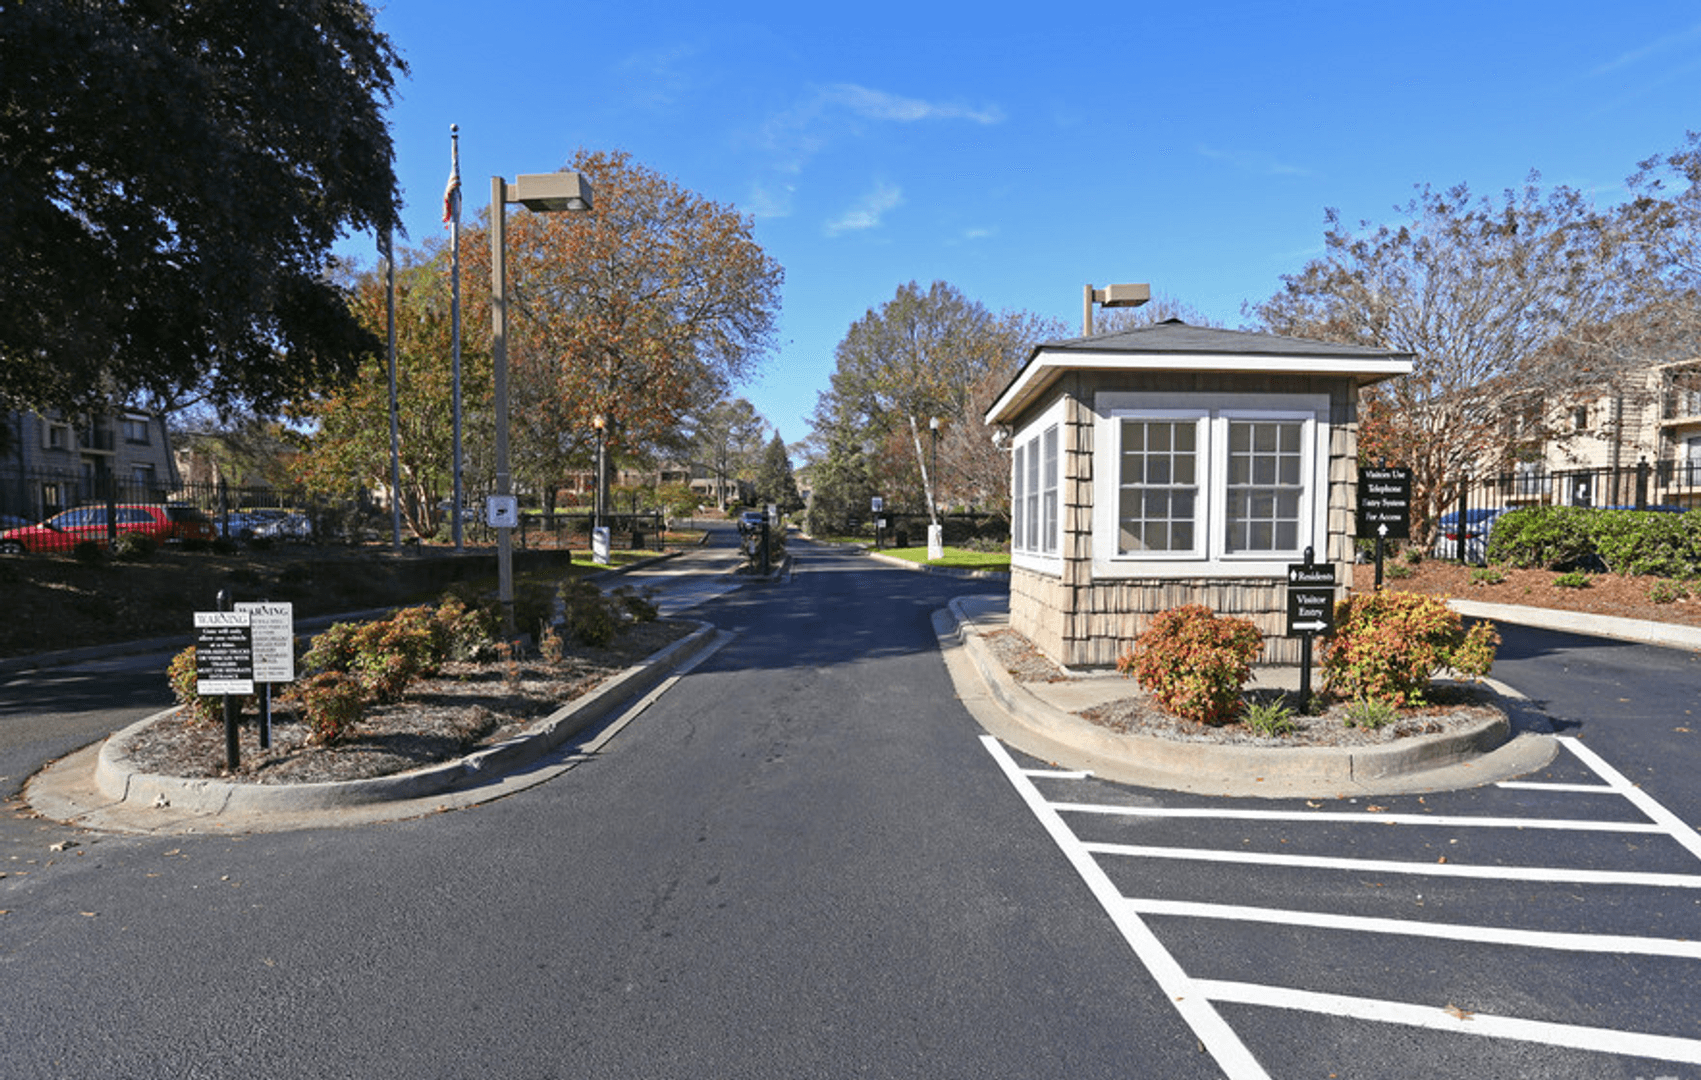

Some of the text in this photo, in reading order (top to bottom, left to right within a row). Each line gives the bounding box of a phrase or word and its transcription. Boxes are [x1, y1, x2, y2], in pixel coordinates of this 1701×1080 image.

[1367, 484, 1402, 495] Telephone
[1362, 498, 1406, 508] Entry System
[1365, 512, 1402, 521] For Access
[1298, 571, 1334, 581] Residents
[1296, 594, 1327, 604] Visitor
[1298, 607, 1324, 618] Entry
[197, 613, 248, 624] WARNING
